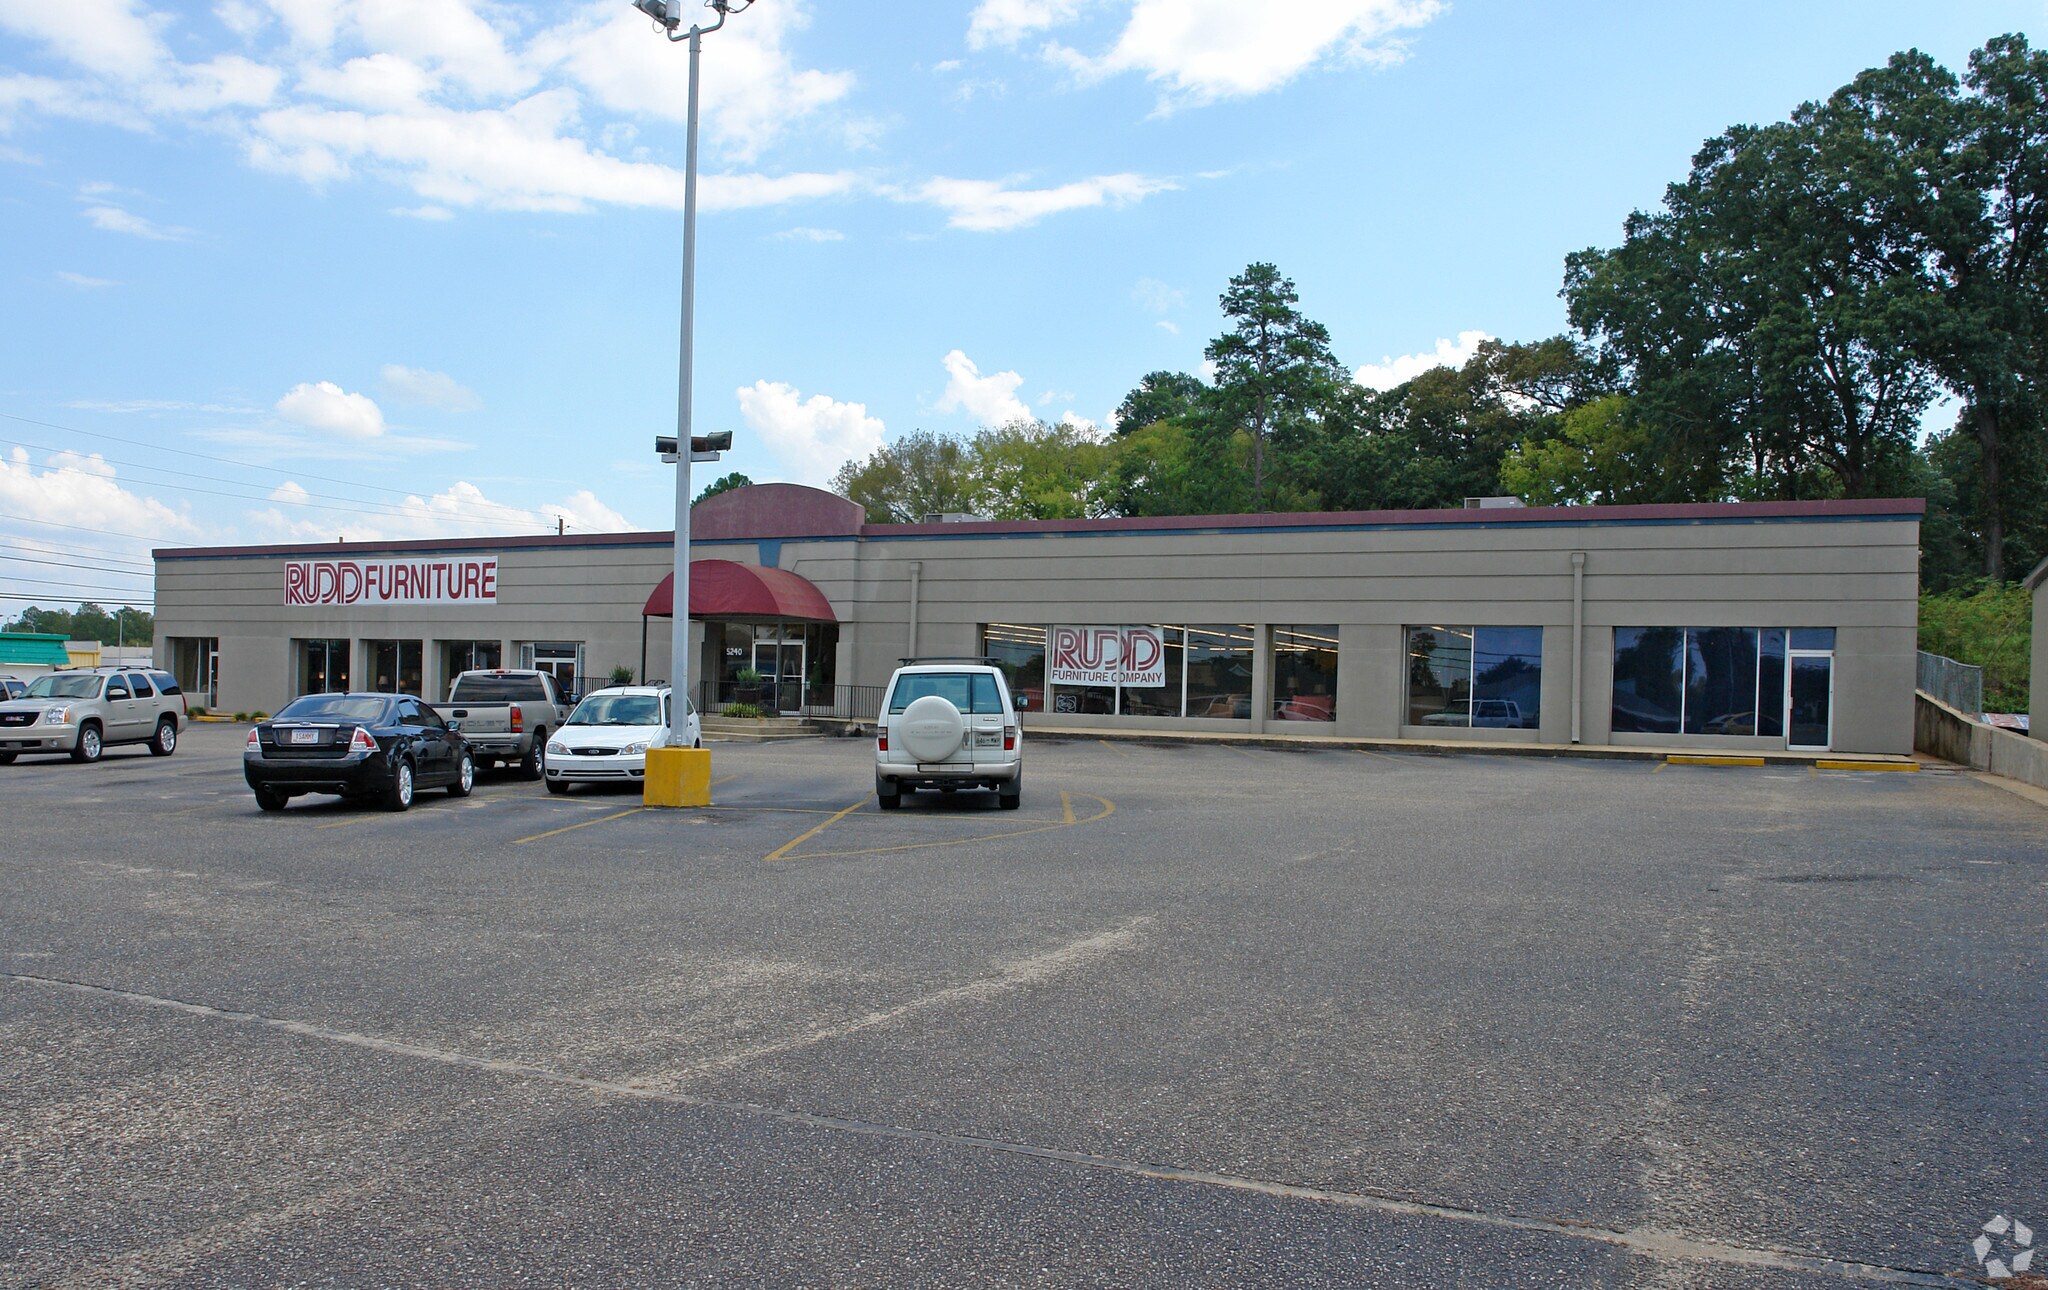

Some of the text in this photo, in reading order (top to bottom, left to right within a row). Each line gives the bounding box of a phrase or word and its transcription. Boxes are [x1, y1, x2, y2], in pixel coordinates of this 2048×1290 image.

[286, 562, 497, 604] RUDD FURNITURE
[724, 645, 742, 656] 5240
[1053, 628, 1161, 671] RUDD
[1052, 670, 1162, 683] FURNITURE COMPANY
